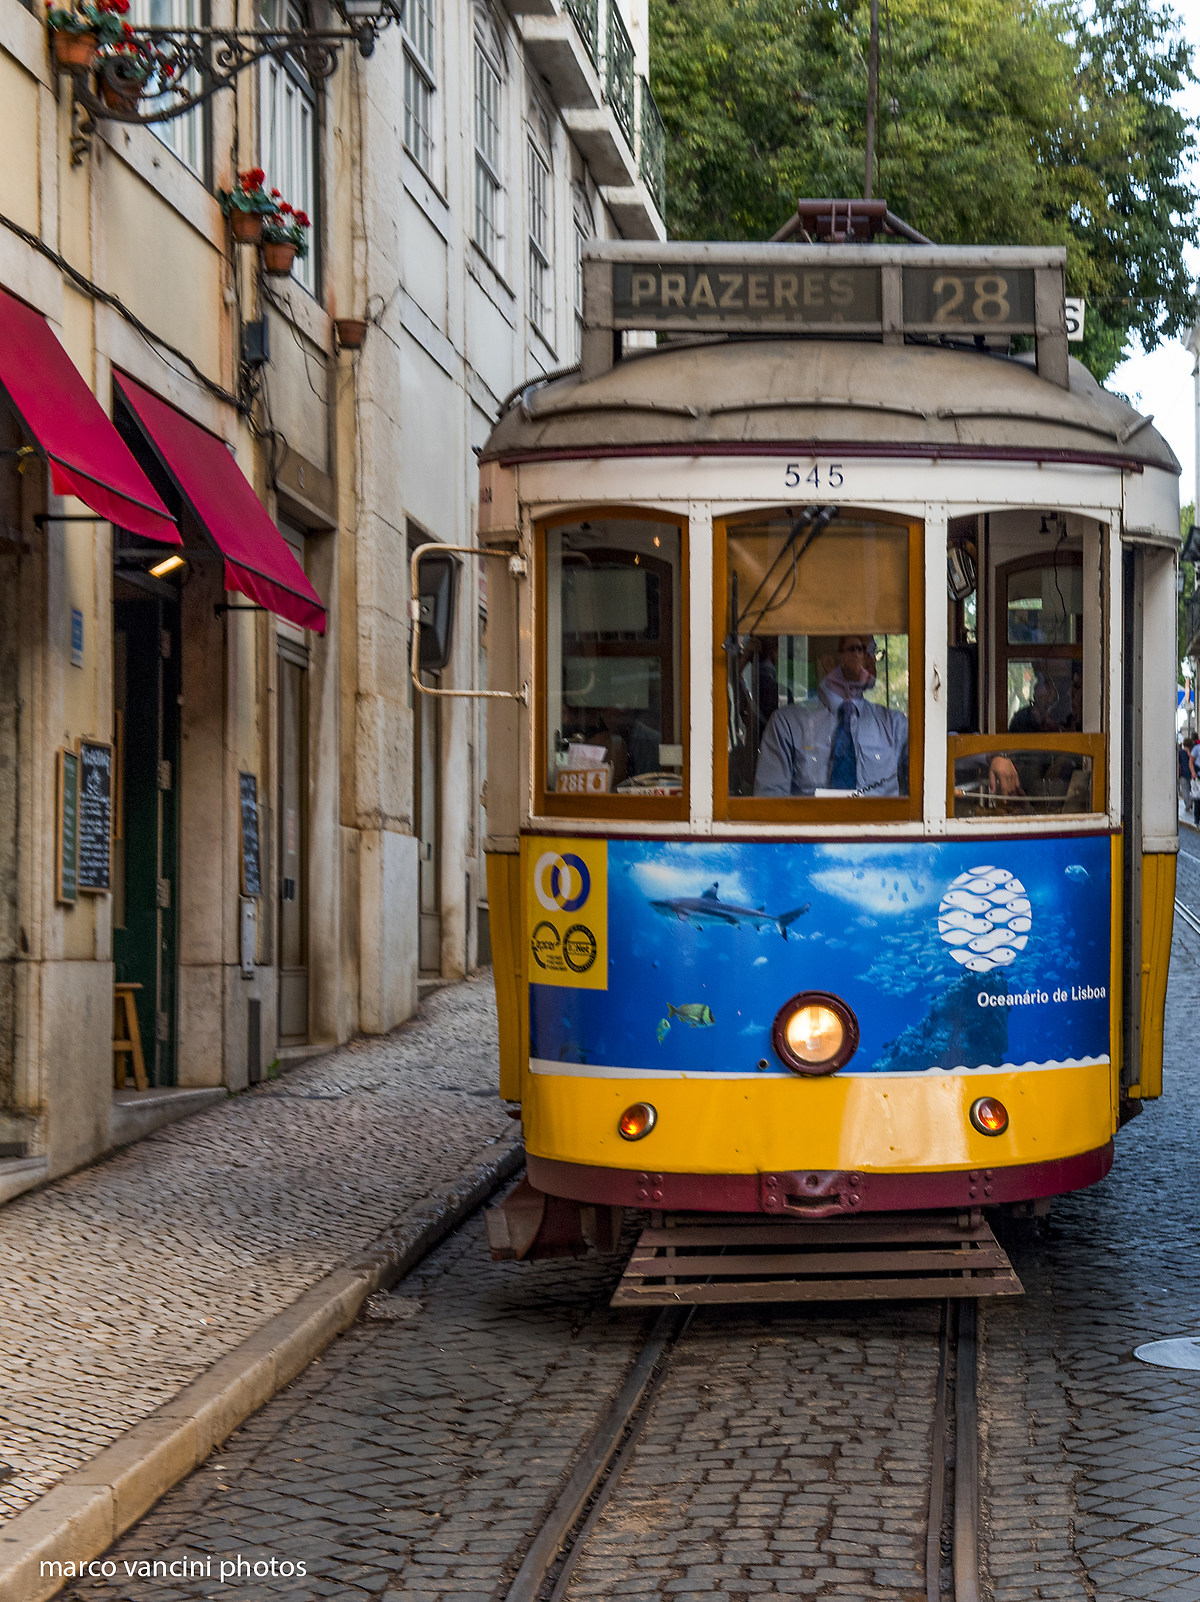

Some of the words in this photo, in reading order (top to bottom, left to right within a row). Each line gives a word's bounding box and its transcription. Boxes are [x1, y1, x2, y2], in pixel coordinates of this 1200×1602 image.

[631, 271, 855, 309] PRAZERES
[931, 274, 1011, 323] 28
[785, 463, 844, 488] 545
[977, 989, 1049, 1007] Oceanário
[1052, 987, 1068, 1003] de
[1071, 985, 1107, 1001] Lisboa
